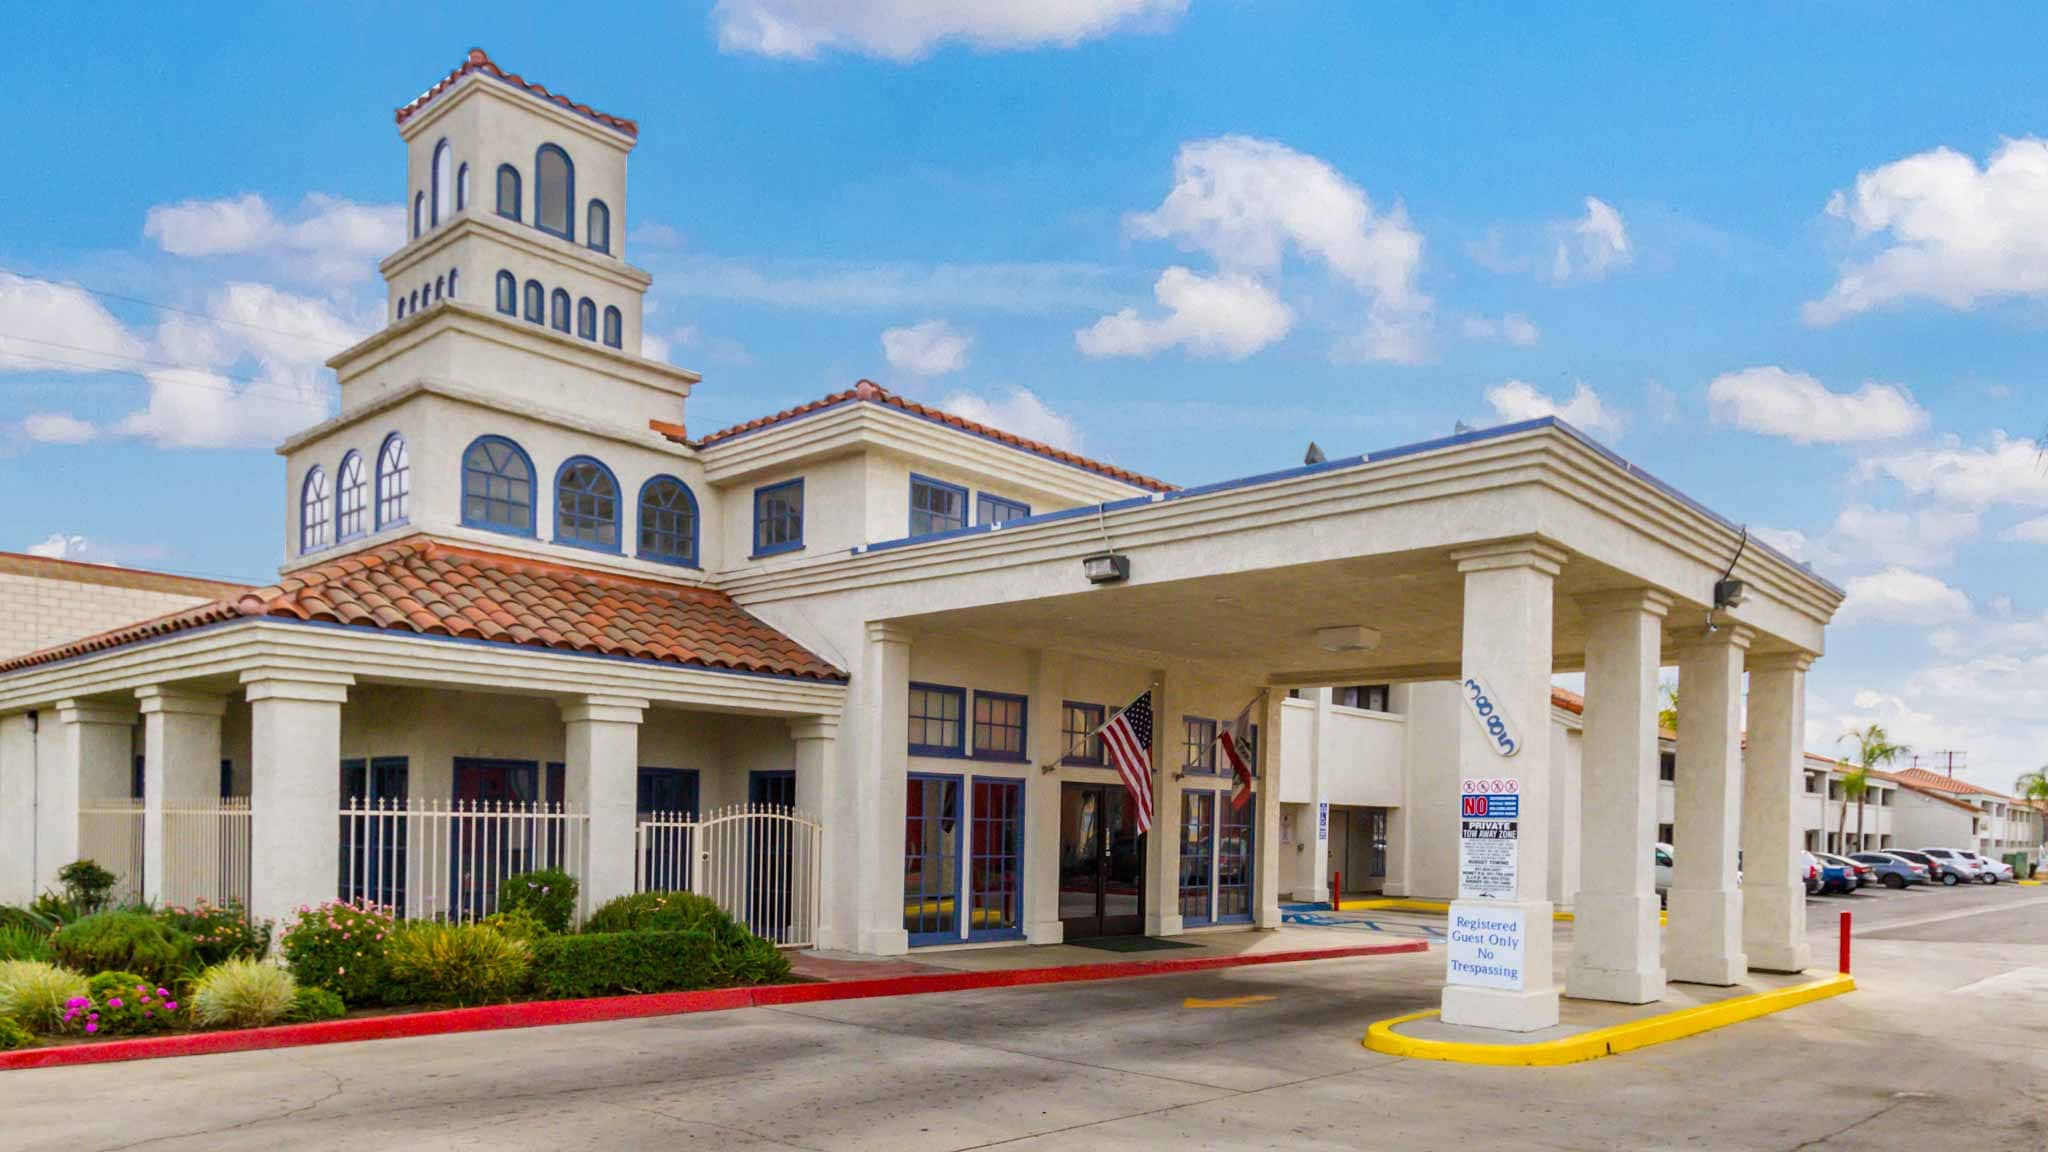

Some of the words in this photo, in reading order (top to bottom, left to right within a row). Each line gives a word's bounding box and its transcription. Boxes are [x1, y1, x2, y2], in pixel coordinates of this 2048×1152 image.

[1464, 679, 1515, 755] 3885
[1464, 797, 1488, 816] NO
[1463, 830, 1478, 838] TOW
[1479, 830, 1497, 838] AWAY
[1498, 830, 1517, 839] ZONE
[1469, 822, 1510, 830] PRIVATE
[1457, 916, 1517, 932] Registered
[1452, 930, 1484, 944] Guest
[1488, 934, 1519, 950] Only
[1478, 947, 1494, 959] No
[1451, 960, 1518, 980] Trespassing
